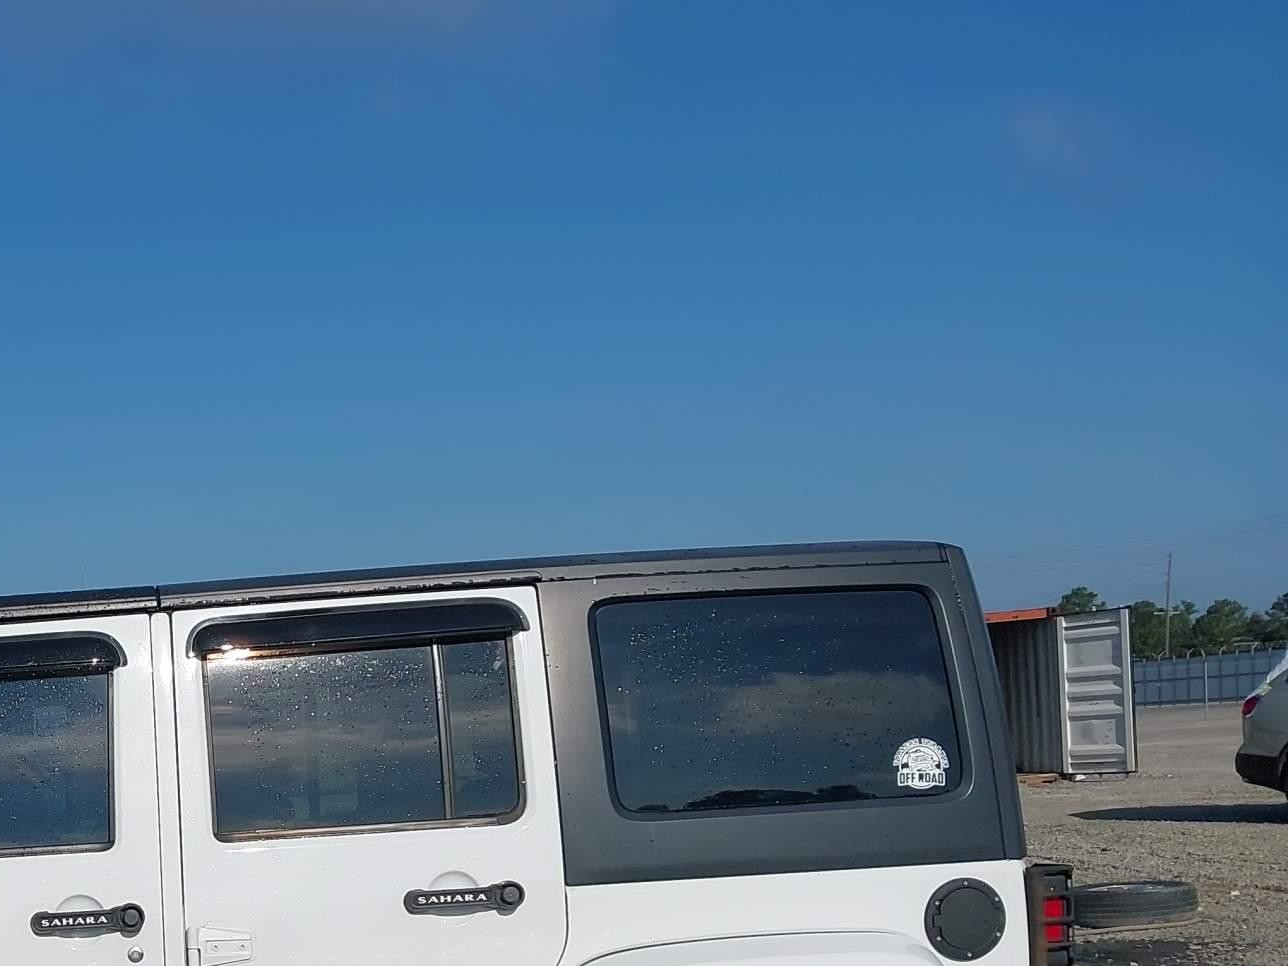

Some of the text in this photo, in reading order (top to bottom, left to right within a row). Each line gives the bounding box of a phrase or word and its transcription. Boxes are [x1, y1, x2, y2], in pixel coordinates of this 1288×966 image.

[899, 772, 944, 785] OFF ROAD
[417, 893, 488, 905] SAHARA
[41, 915, 109, 927] SAHARA
